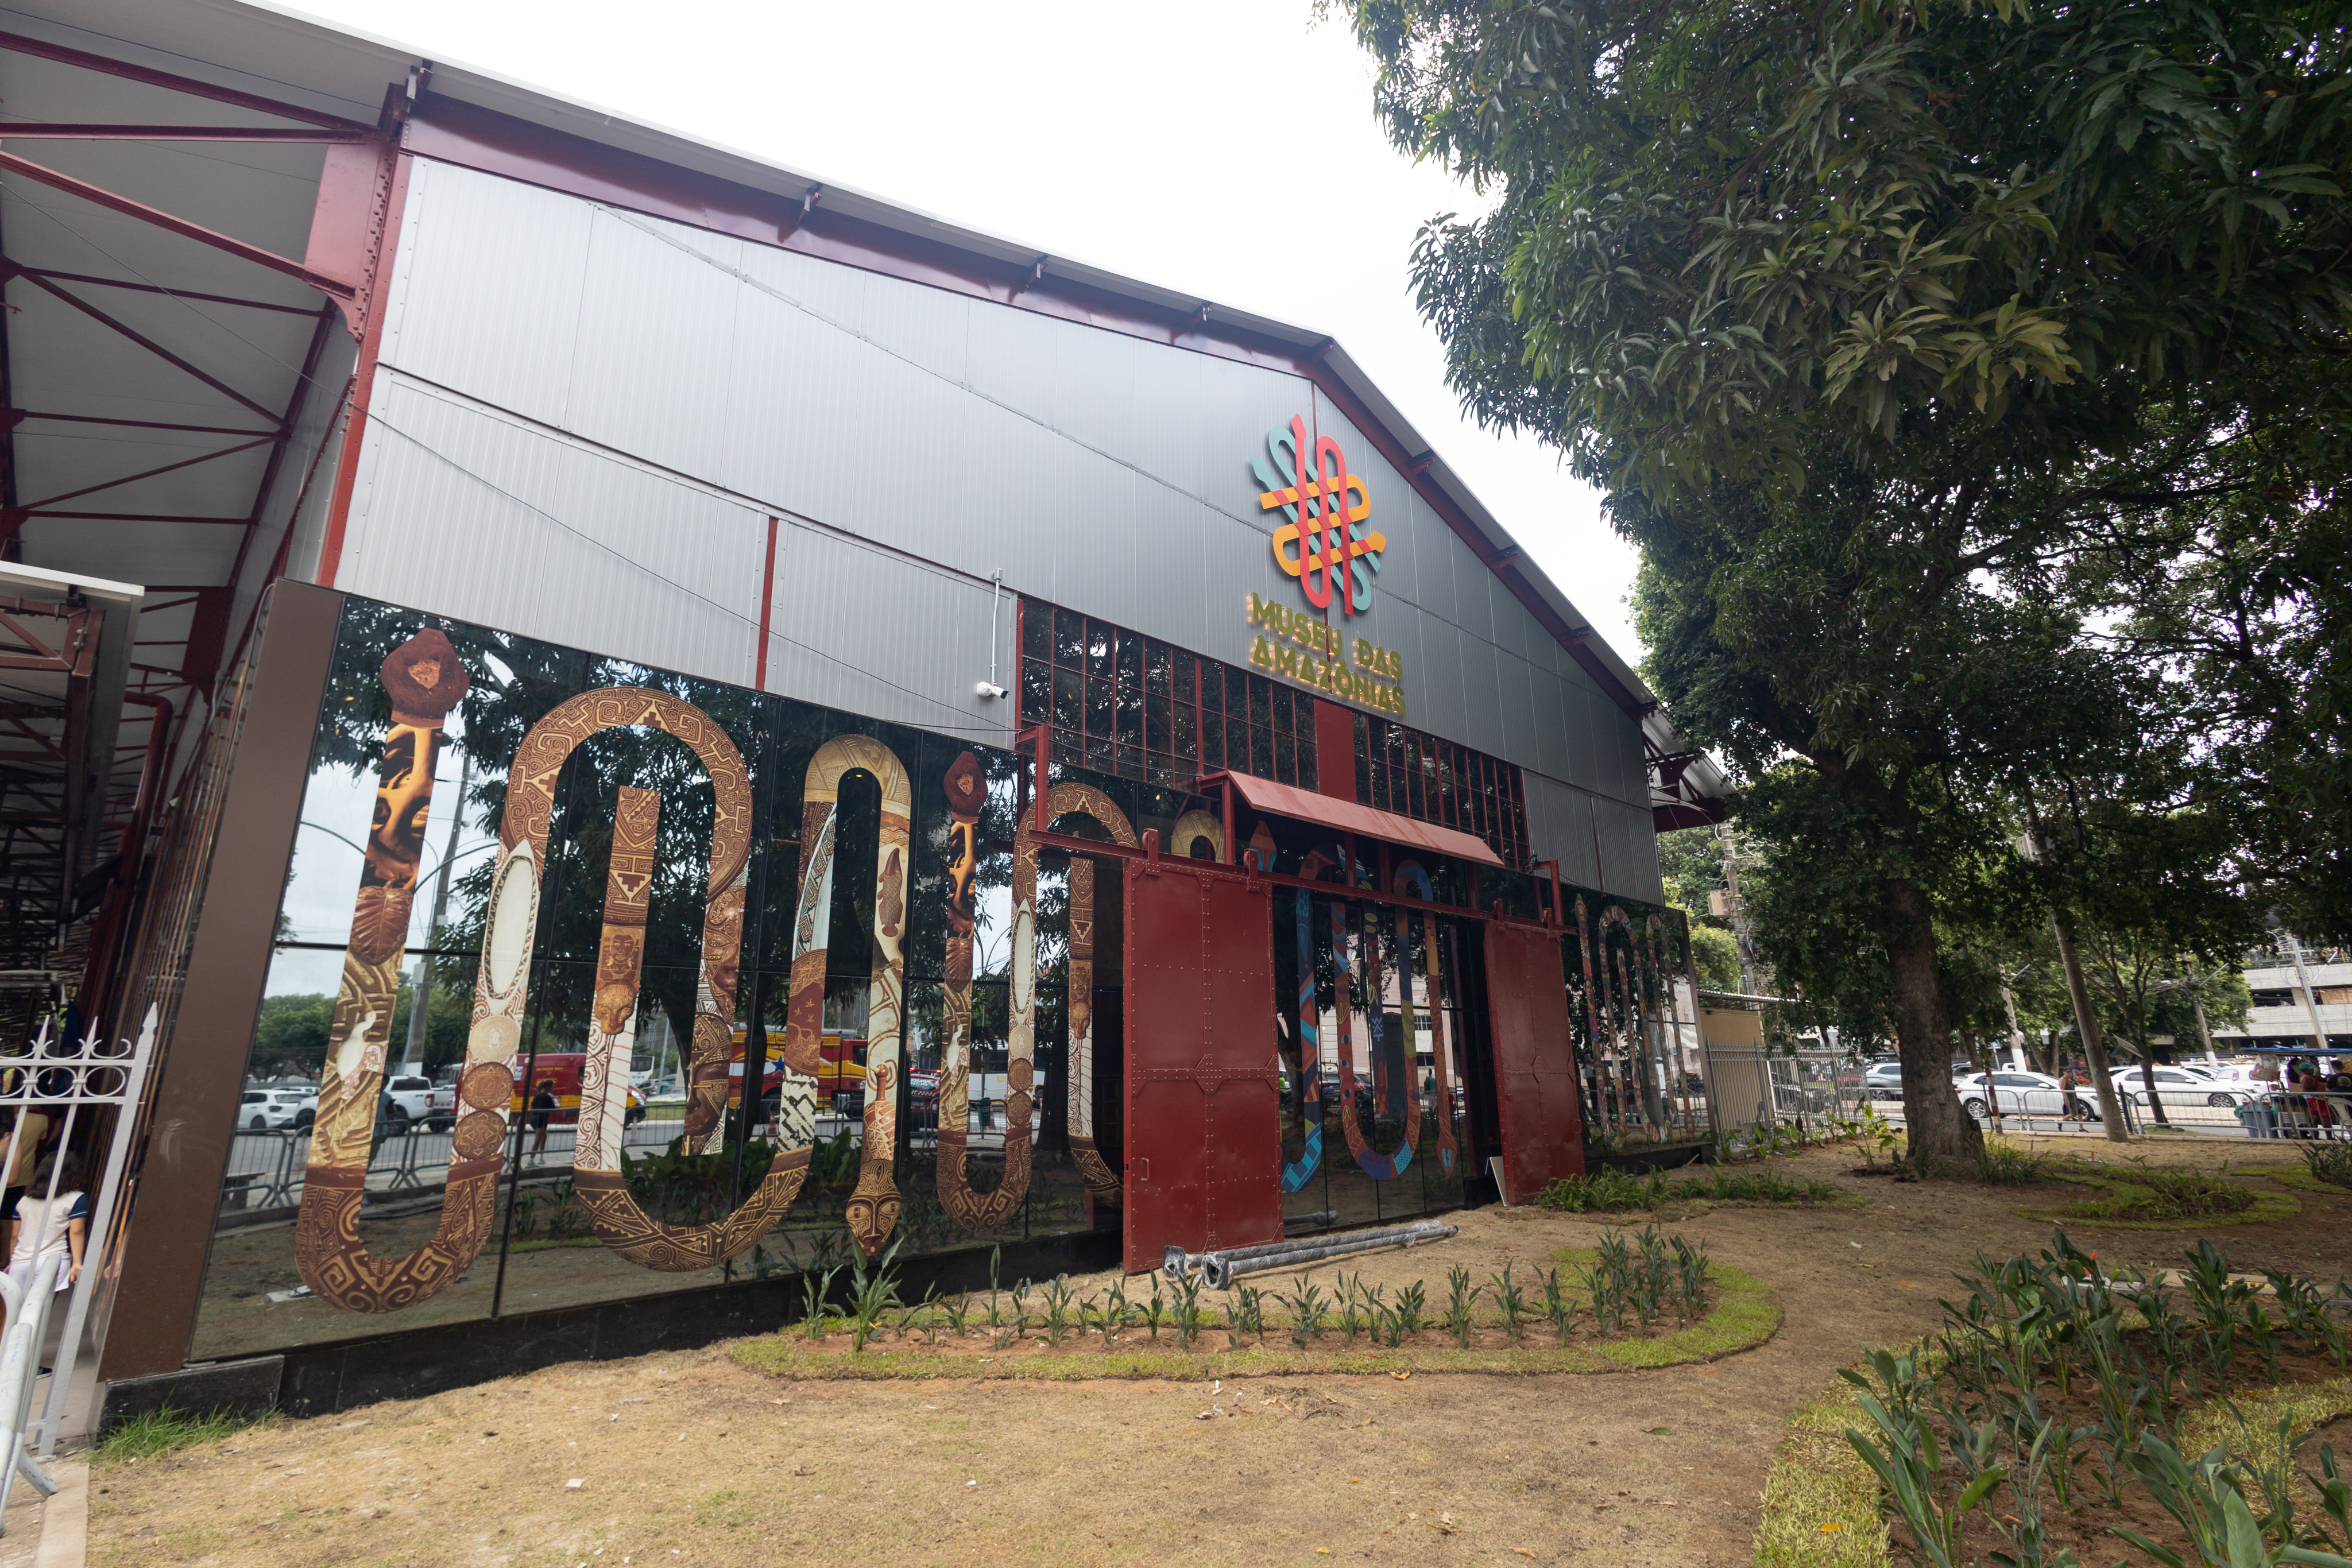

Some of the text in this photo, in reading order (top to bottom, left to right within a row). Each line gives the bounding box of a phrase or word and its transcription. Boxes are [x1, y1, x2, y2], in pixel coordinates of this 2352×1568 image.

[1252, 591, 1403, 679] MUSEU DAS
[1252, 634, 1406, 714] AMAZÔNIAS
